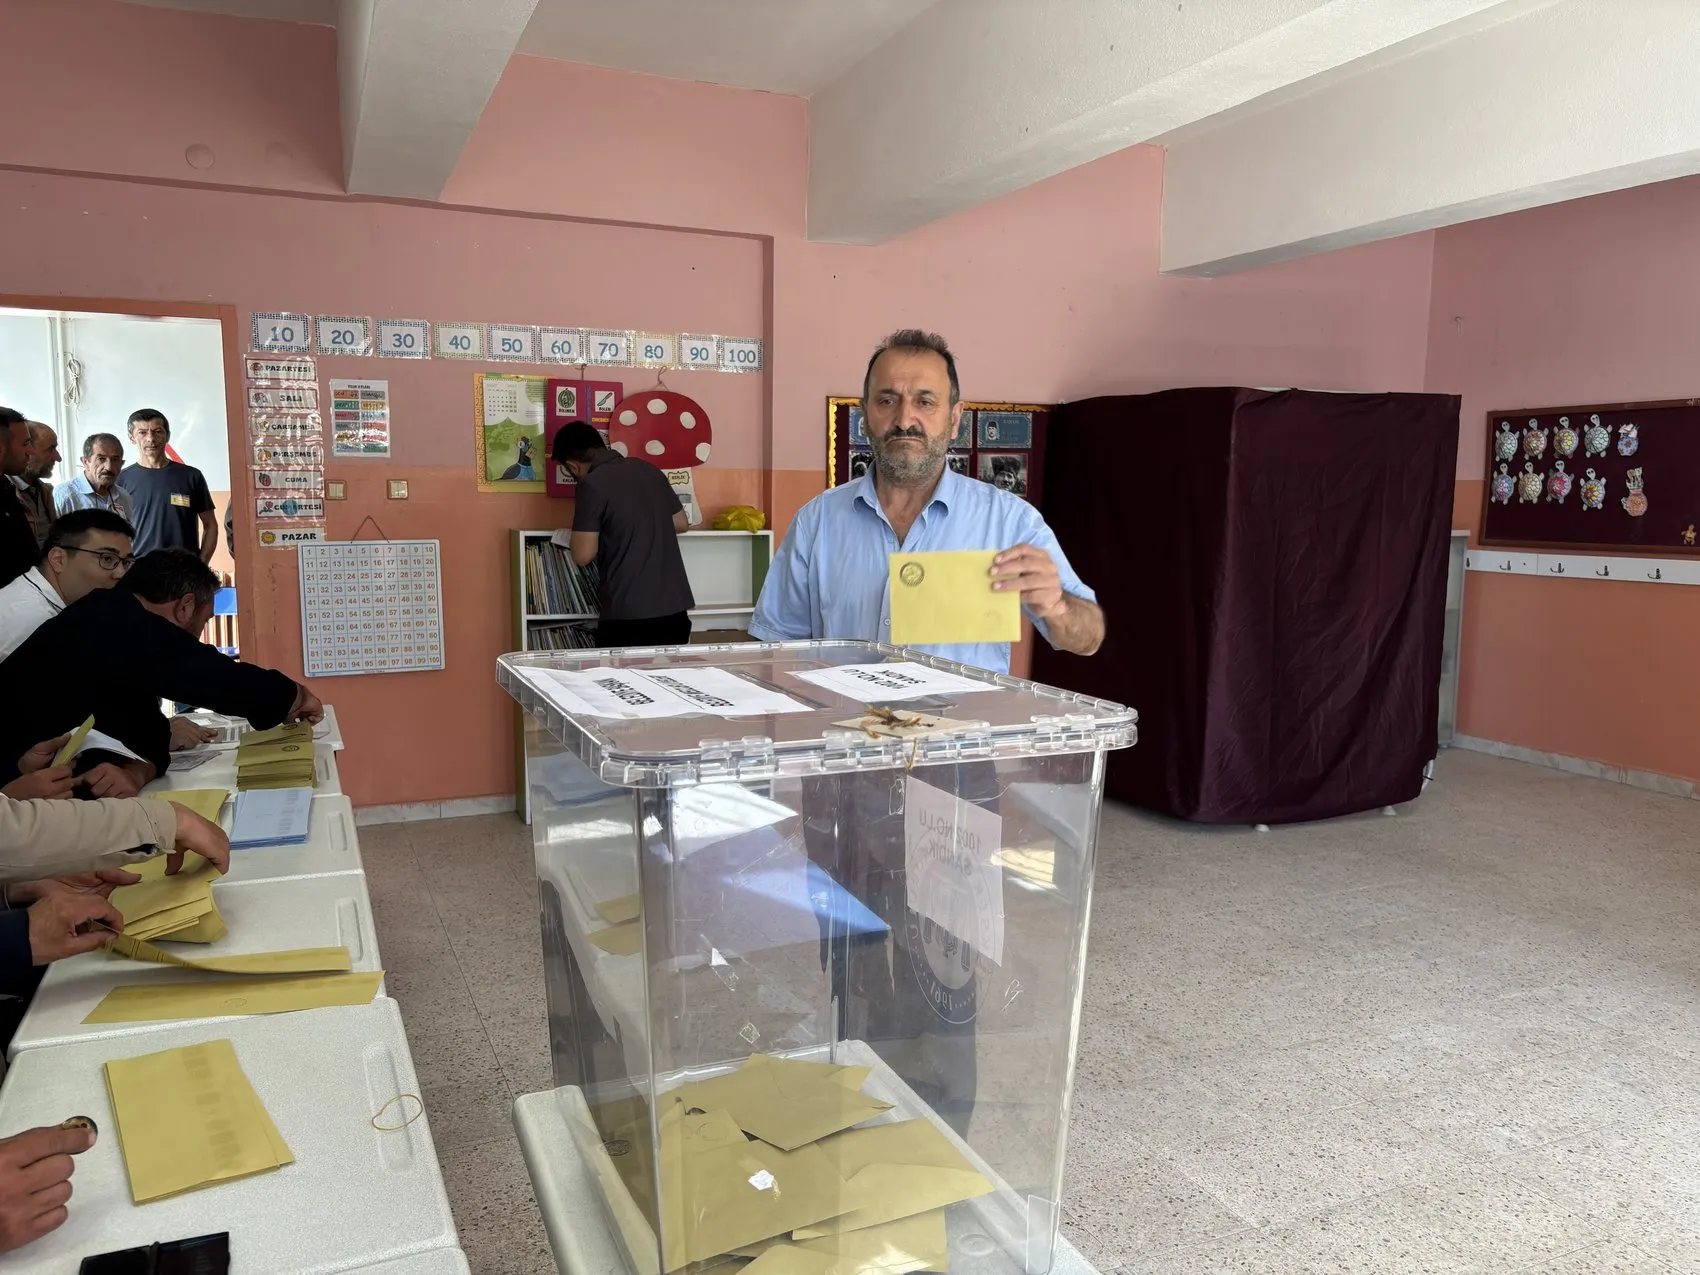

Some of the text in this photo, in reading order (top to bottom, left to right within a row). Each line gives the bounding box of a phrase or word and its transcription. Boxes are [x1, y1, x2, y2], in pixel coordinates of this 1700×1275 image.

[270, 326, 294, 342] 10
[331, 330, 354, 345] 20
[392, 333, 415, 348] 30
[449, 335, 471, 350] 40
[501, 338, 523, 353] 50
[550, 340, 572, 355] 60
[598, 343, 619, 357] 70
[644, 345, 664, 359] 80
[690, 347, 709, 361] 90
[728, 349, 756, 363] 100
